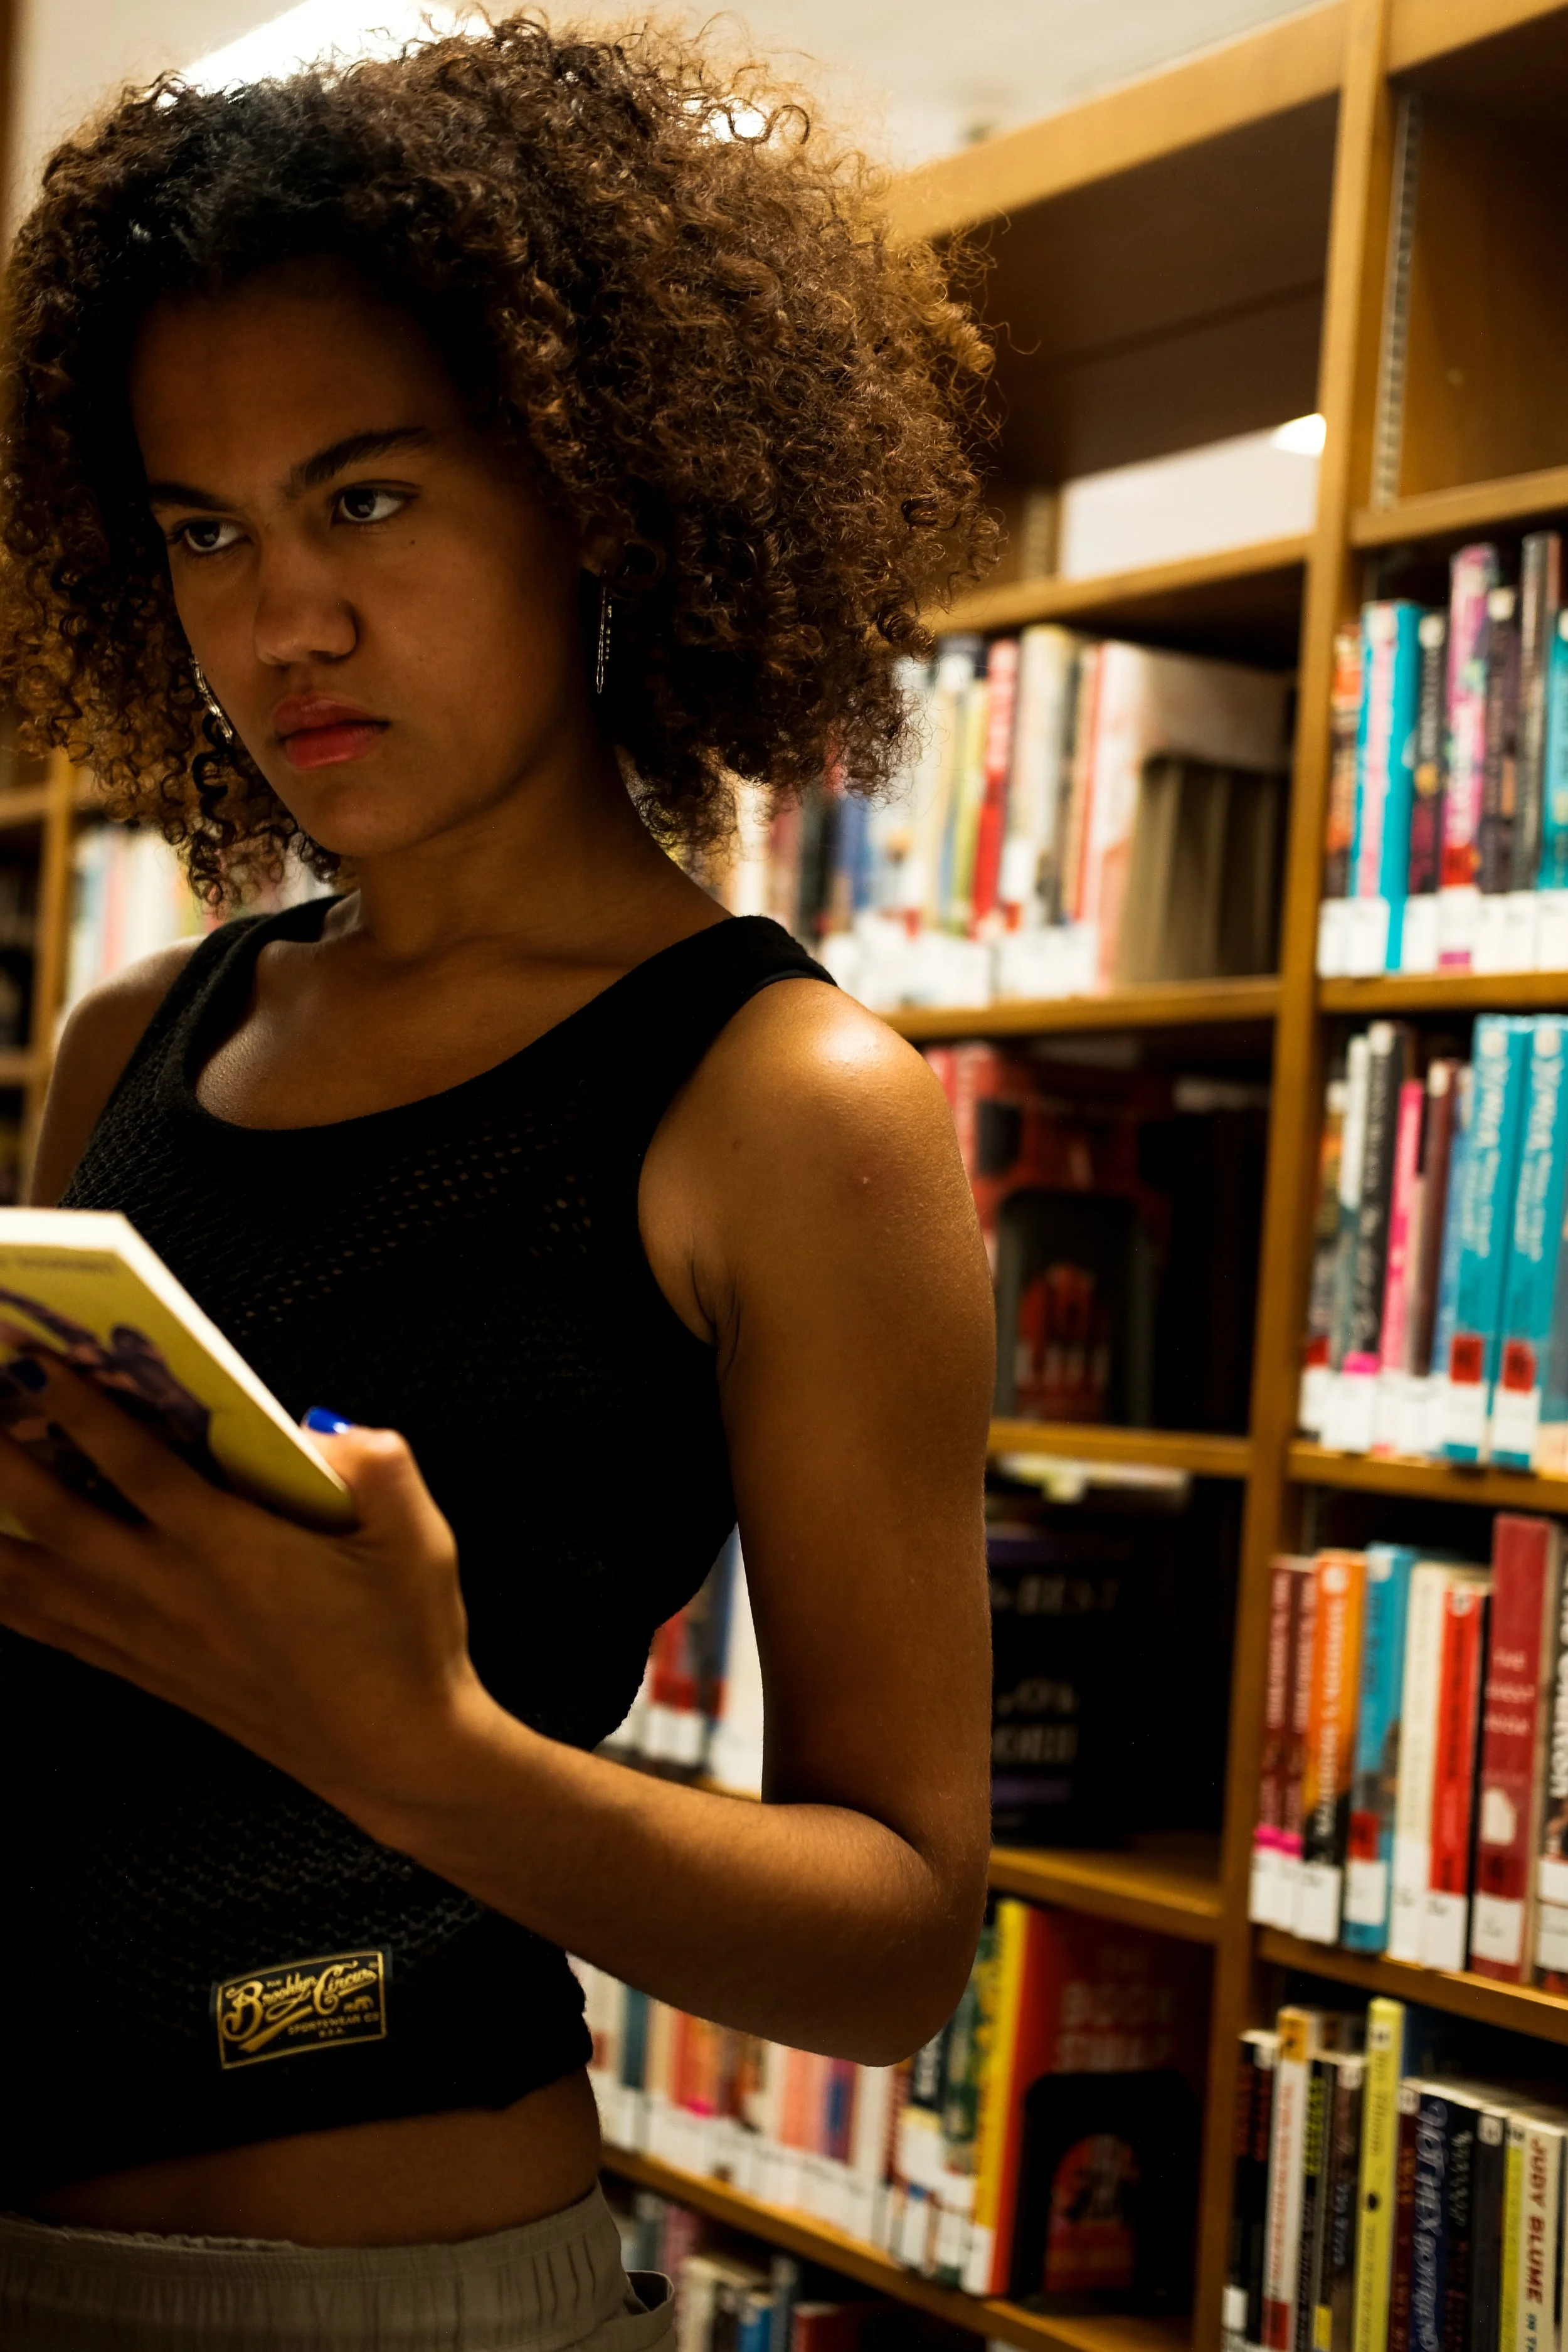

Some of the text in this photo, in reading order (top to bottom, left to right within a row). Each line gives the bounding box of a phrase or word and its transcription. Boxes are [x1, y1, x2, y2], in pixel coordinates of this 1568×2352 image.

[223, 1960, 376, 2041] Brooklyn Circus
[1530, 2137, 1547, 2209] JUDY
[1526, 2216, 1545, 2306] BLUME
